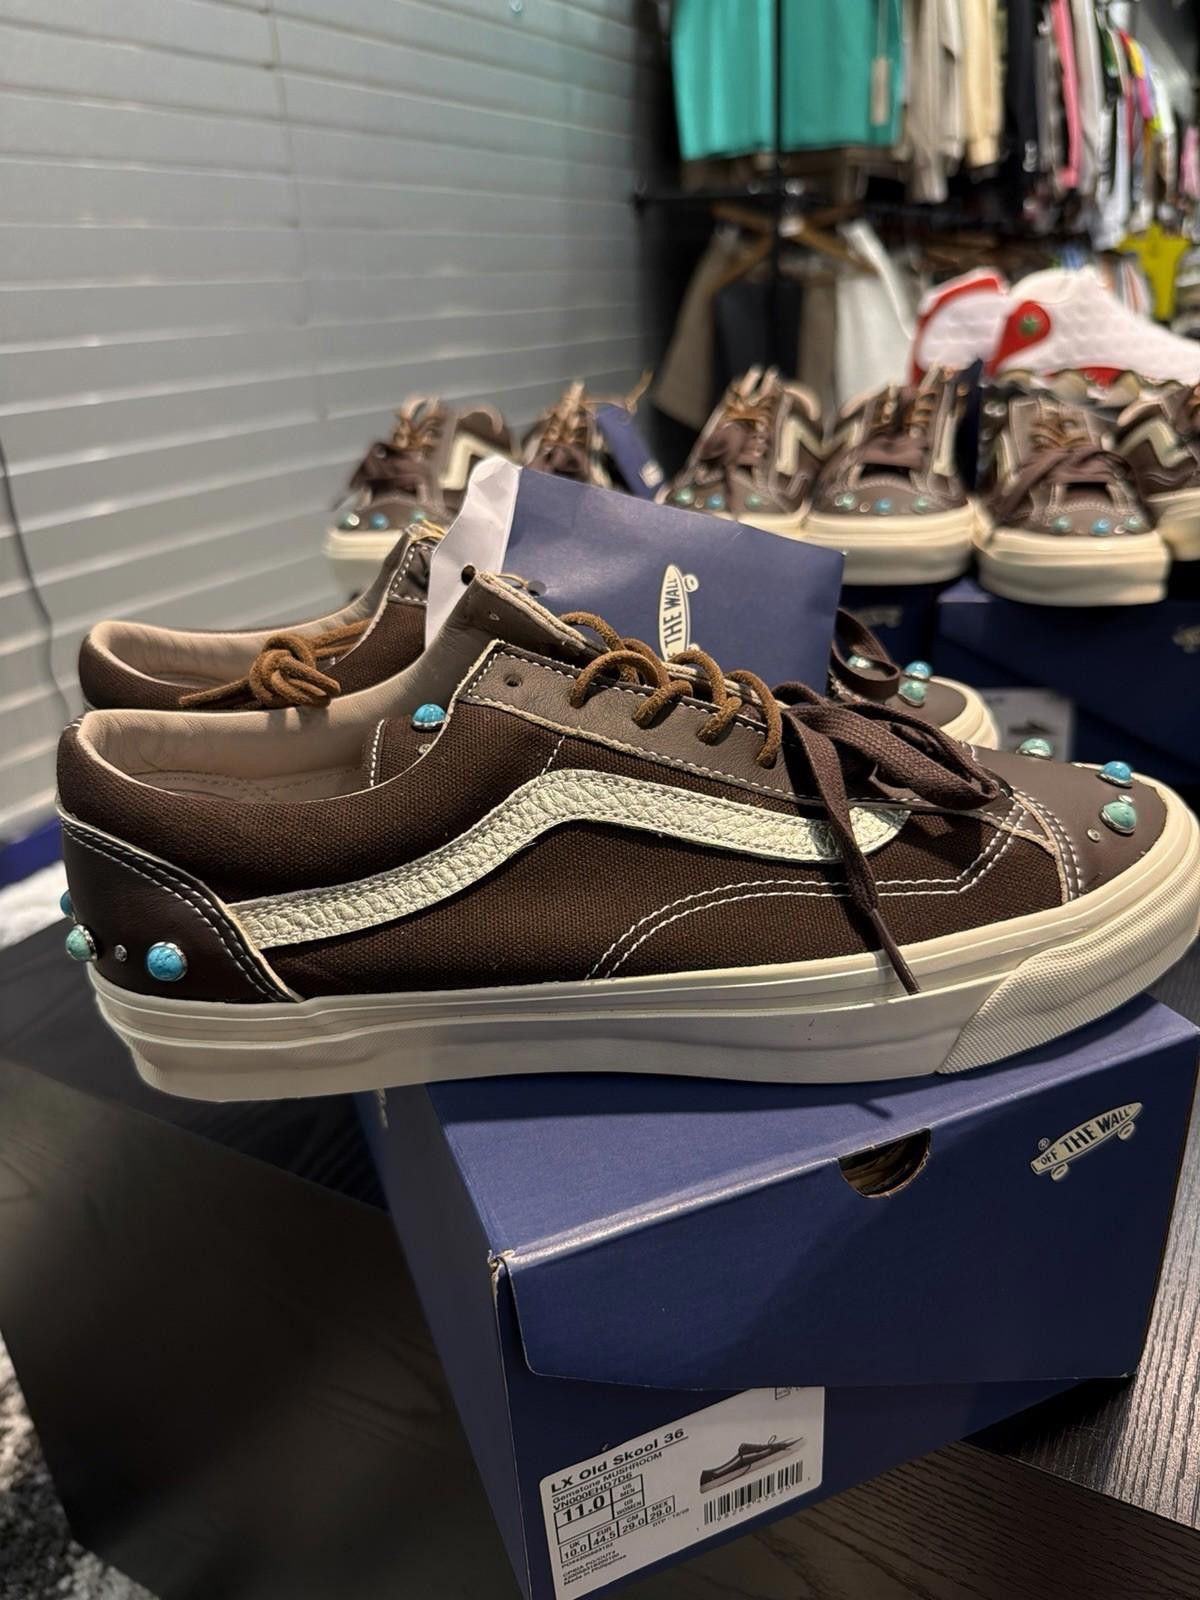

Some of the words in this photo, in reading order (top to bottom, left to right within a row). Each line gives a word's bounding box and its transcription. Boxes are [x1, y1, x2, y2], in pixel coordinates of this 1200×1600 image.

[663, 612, 682, 648] THE
[1060, 1124, 1098, 1153] THE
[551, 1475, 573, 1493] LX
[579, 1461, 607, 1480] Old
[613, 1440, 658, 1466] Skool
[664, 1428, 684, 1444] 36
[553, 1480, 600, 1504] Gemstone
[602, 1452, 662, 1482] MUSHROOM
[563, 1495, 605, 1521] 11.0
[626, 1514, 639, 1523] CM
[564, 1545, 587, 1559] 10.0
[593, 1532, 616, 1546] 44.5
[622, 1518, 644, 1533] 29.0
